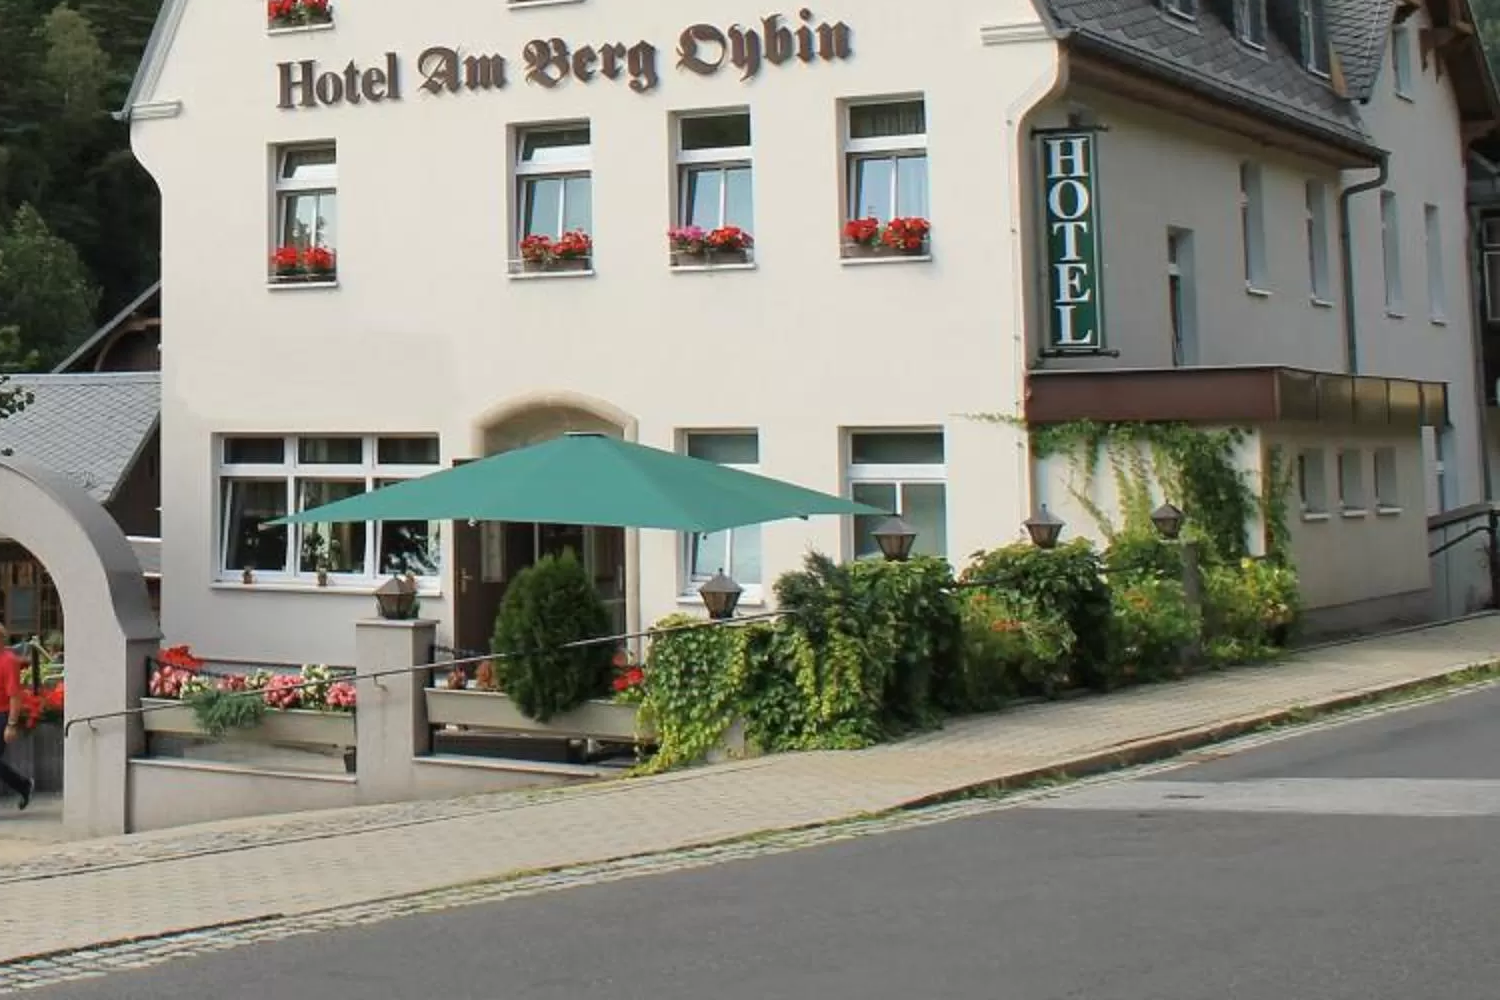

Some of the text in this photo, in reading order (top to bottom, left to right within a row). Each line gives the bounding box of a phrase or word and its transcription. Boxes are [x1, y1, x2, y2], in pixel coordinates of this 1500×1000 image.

[276, 8, 853, 109] Hotel Am Berg Oybin
[1045, 137, 1093, 345] HOTEL
